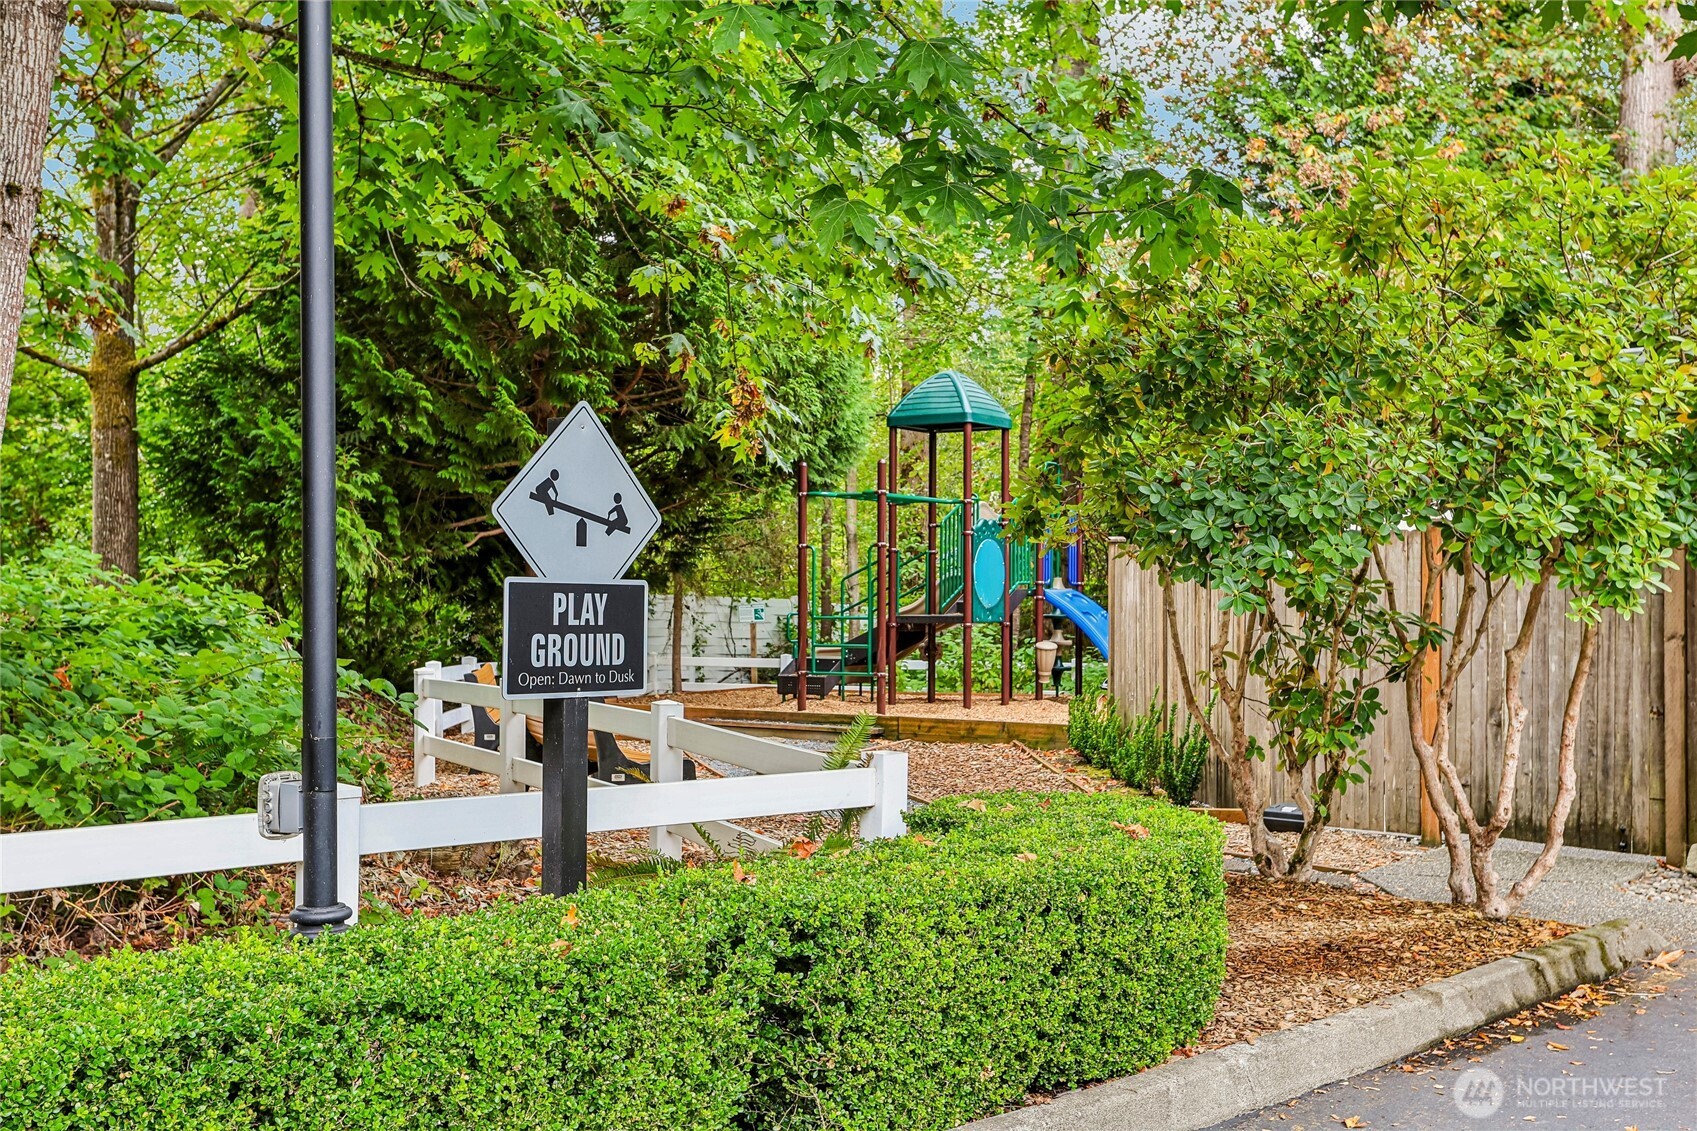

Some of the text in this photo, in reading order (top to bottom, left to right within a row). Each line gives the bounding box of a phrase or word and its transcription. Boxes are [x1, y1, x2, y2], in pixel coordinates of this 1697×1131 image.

[553, 592, 608, 626] PLAY
[530, 633, 625, 668] GROUND
[518, 668, 635, 689] Open: Dawn to Dusk
